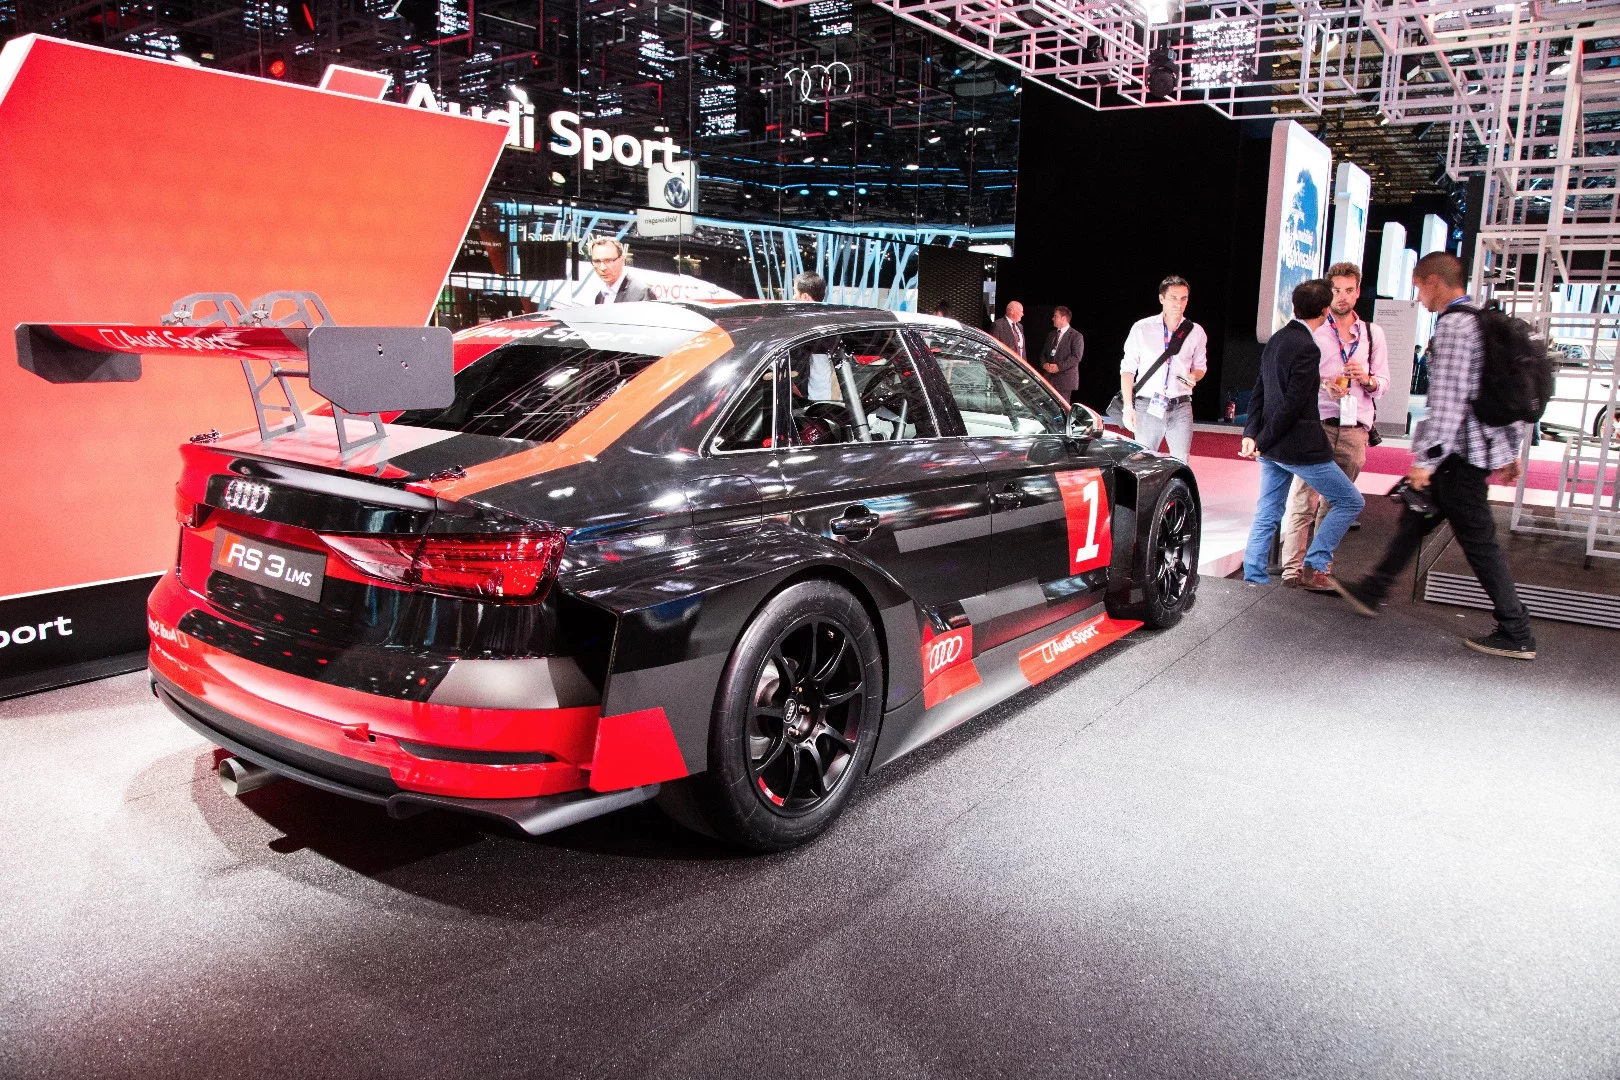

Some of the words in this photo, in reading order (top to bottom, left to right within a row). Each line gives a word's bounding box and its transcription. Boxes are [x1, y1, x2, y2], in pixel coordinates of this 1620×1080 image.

[550, 110, 681, 173] Sport
[118, 329, 174, 349] Audi
[162, 330, 238, 352] Sport
[543, 326, 650, 345] Sport
[1075, 480, 1100, 563] 1
[227, 542, 263, 571] RS
[264, 554, 286, 578] 3
[284, 567, 313, 587] LMS
[1053, 634, 1076, 655] Audi
[1071, 624, 1100, 644] Sport
